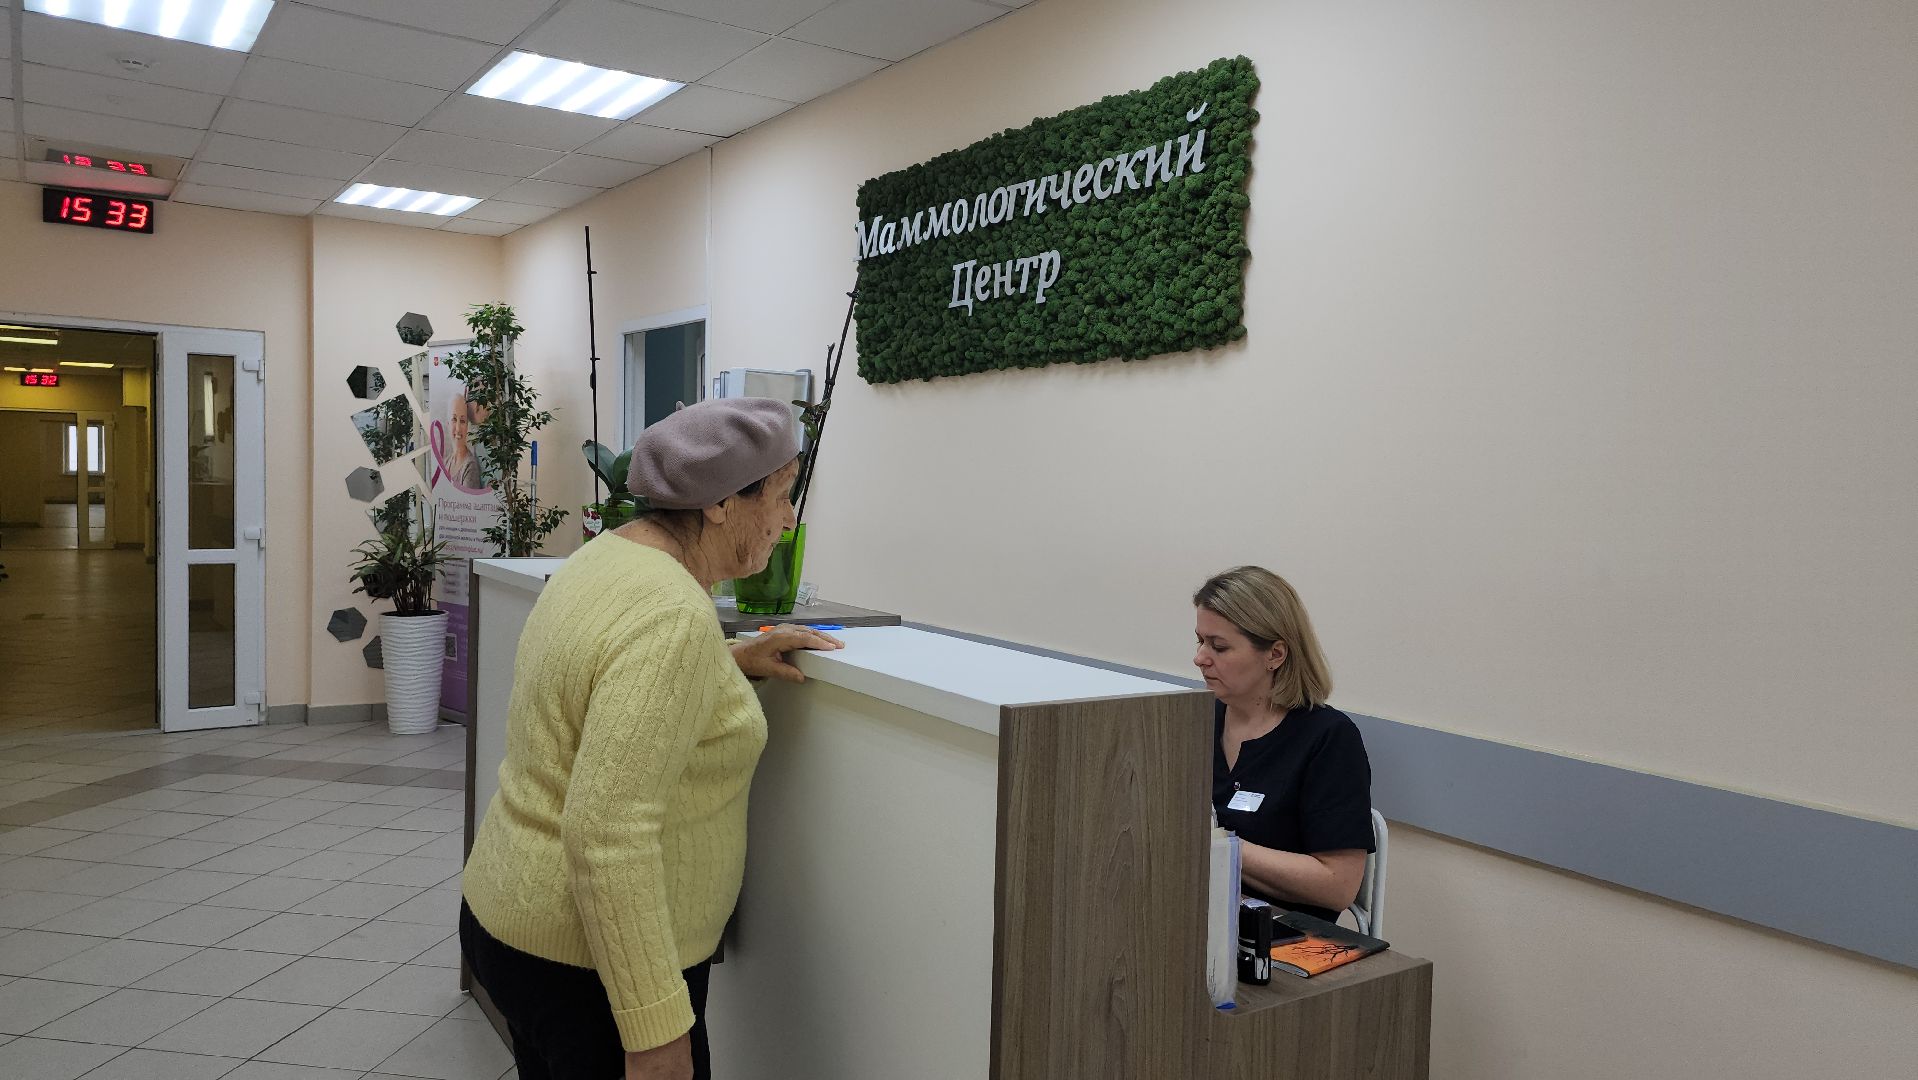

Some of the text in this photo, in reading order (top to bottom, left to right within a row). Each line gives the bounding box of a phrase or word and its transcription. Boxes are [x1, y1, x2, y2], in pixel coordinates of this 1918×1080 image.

[60, 196, 148, 229] 15 33
[853, 102, 1209, 262] Маммологический
[948, 248, 1061, 316] Центр
